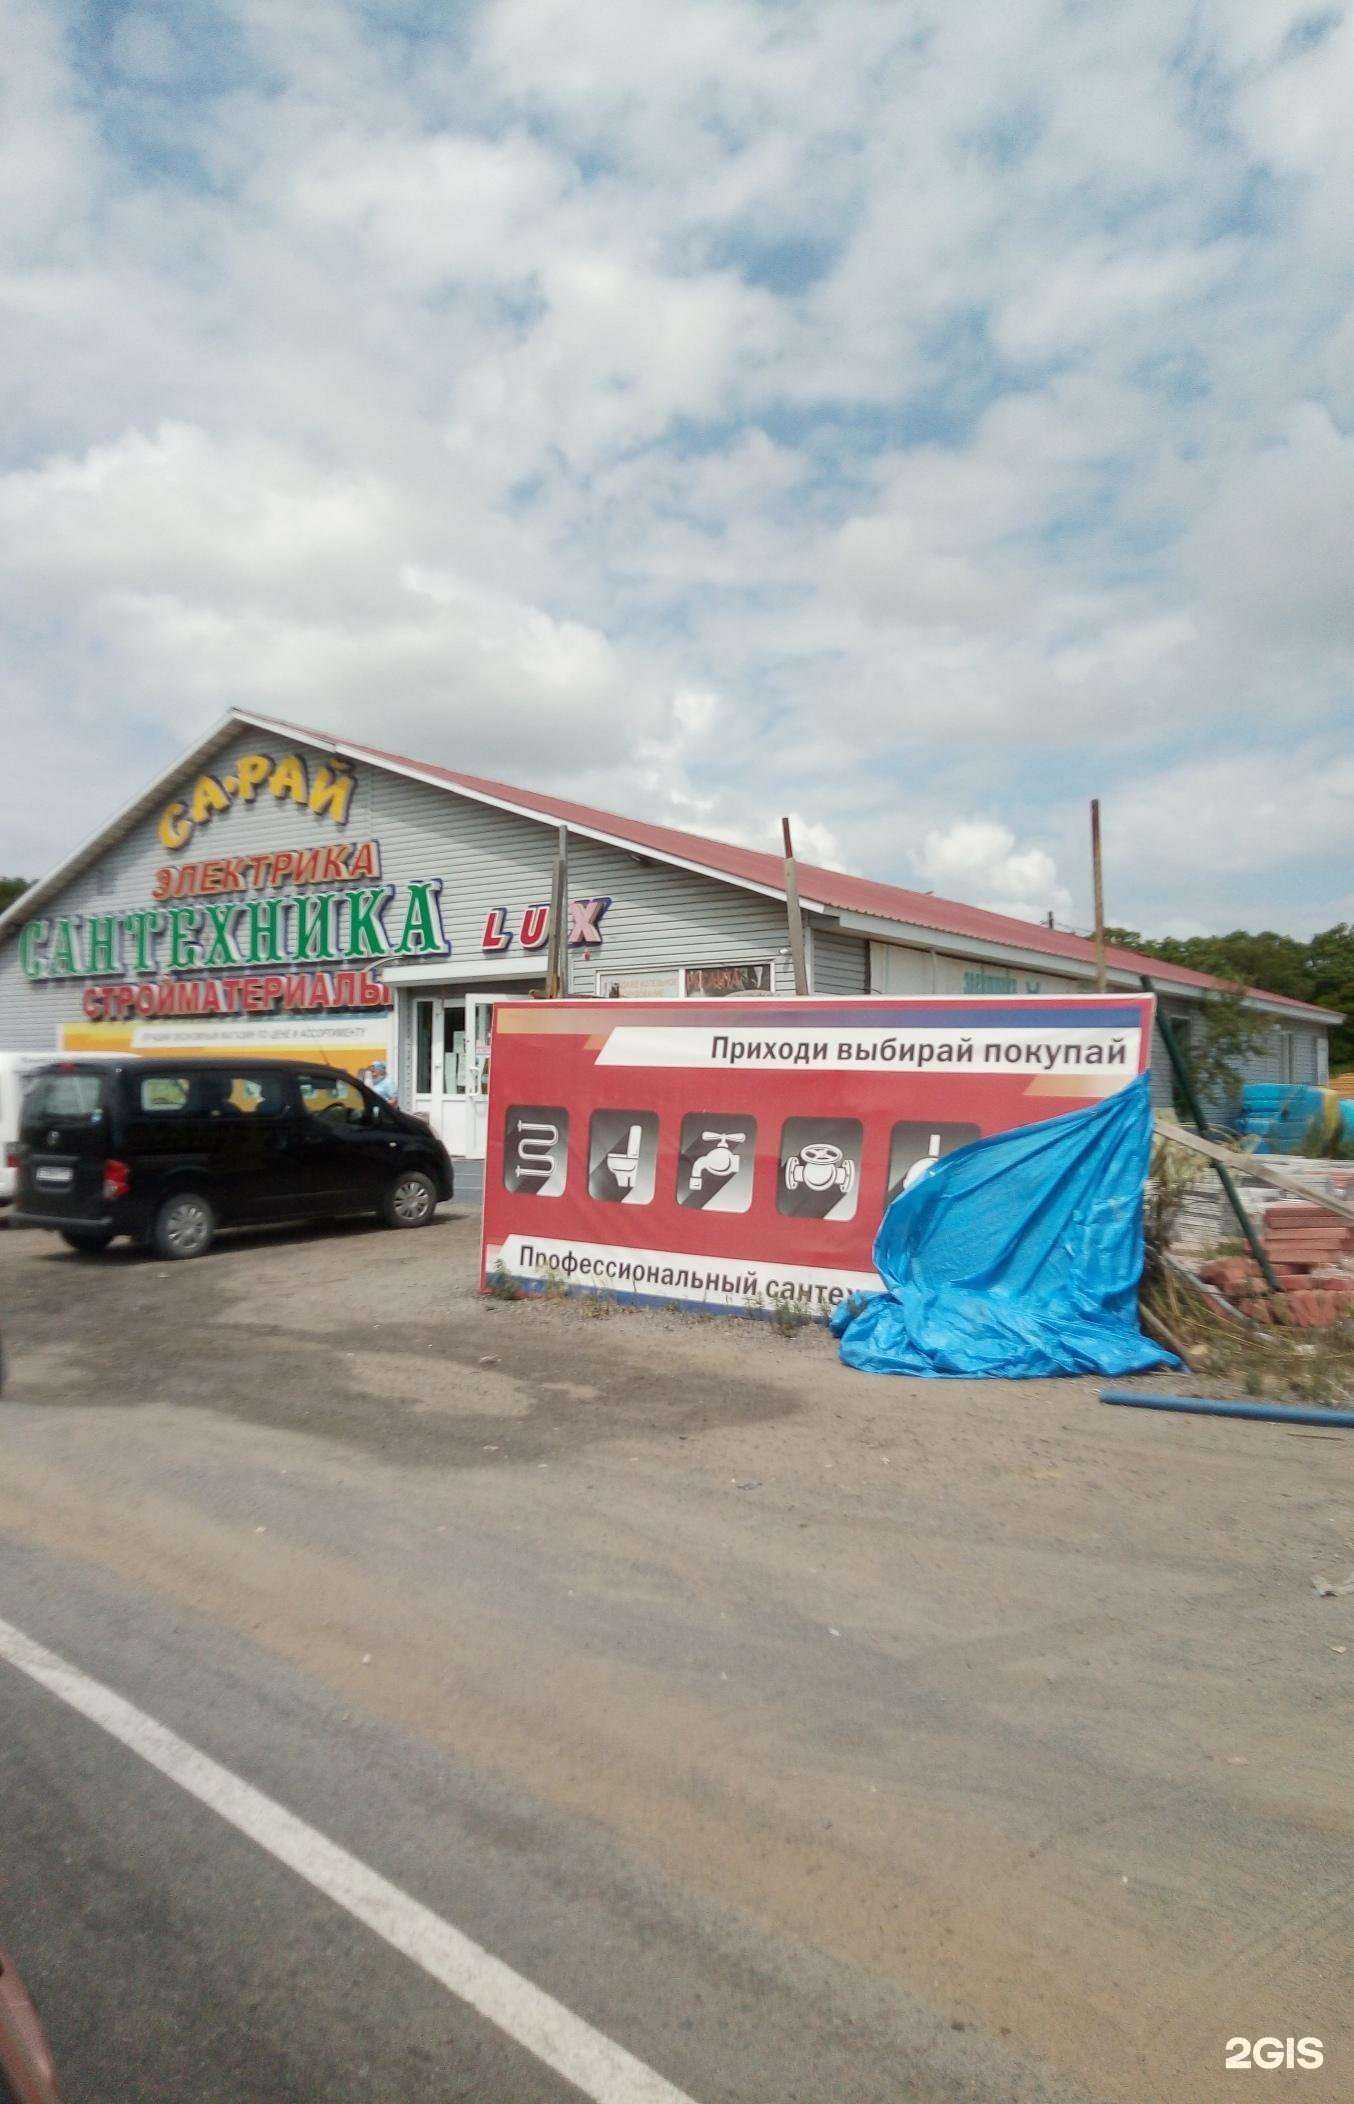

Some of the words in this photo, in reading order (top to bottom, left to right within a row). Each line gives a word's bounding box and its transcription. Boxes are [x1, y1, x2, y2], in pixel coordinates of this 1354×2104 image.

[152, 839, 381, 901] ЭЛЕКТРИКА
[18, 879, 451, 979] САНТЕХНИКА
[481, 897, 611, 952] LUX
[82, 971, 393, 1017] СТРОЙМАТЕРИАЛЫ
[711, 1035, 828, 1065] Приходи
[837, 1037, 974, 1067] выбирай
[983, 1037, 1127, 1071] покупай
[519, 1245, 758, 1297] Профессиональный
[765, 1279, 860, 1306] санте
